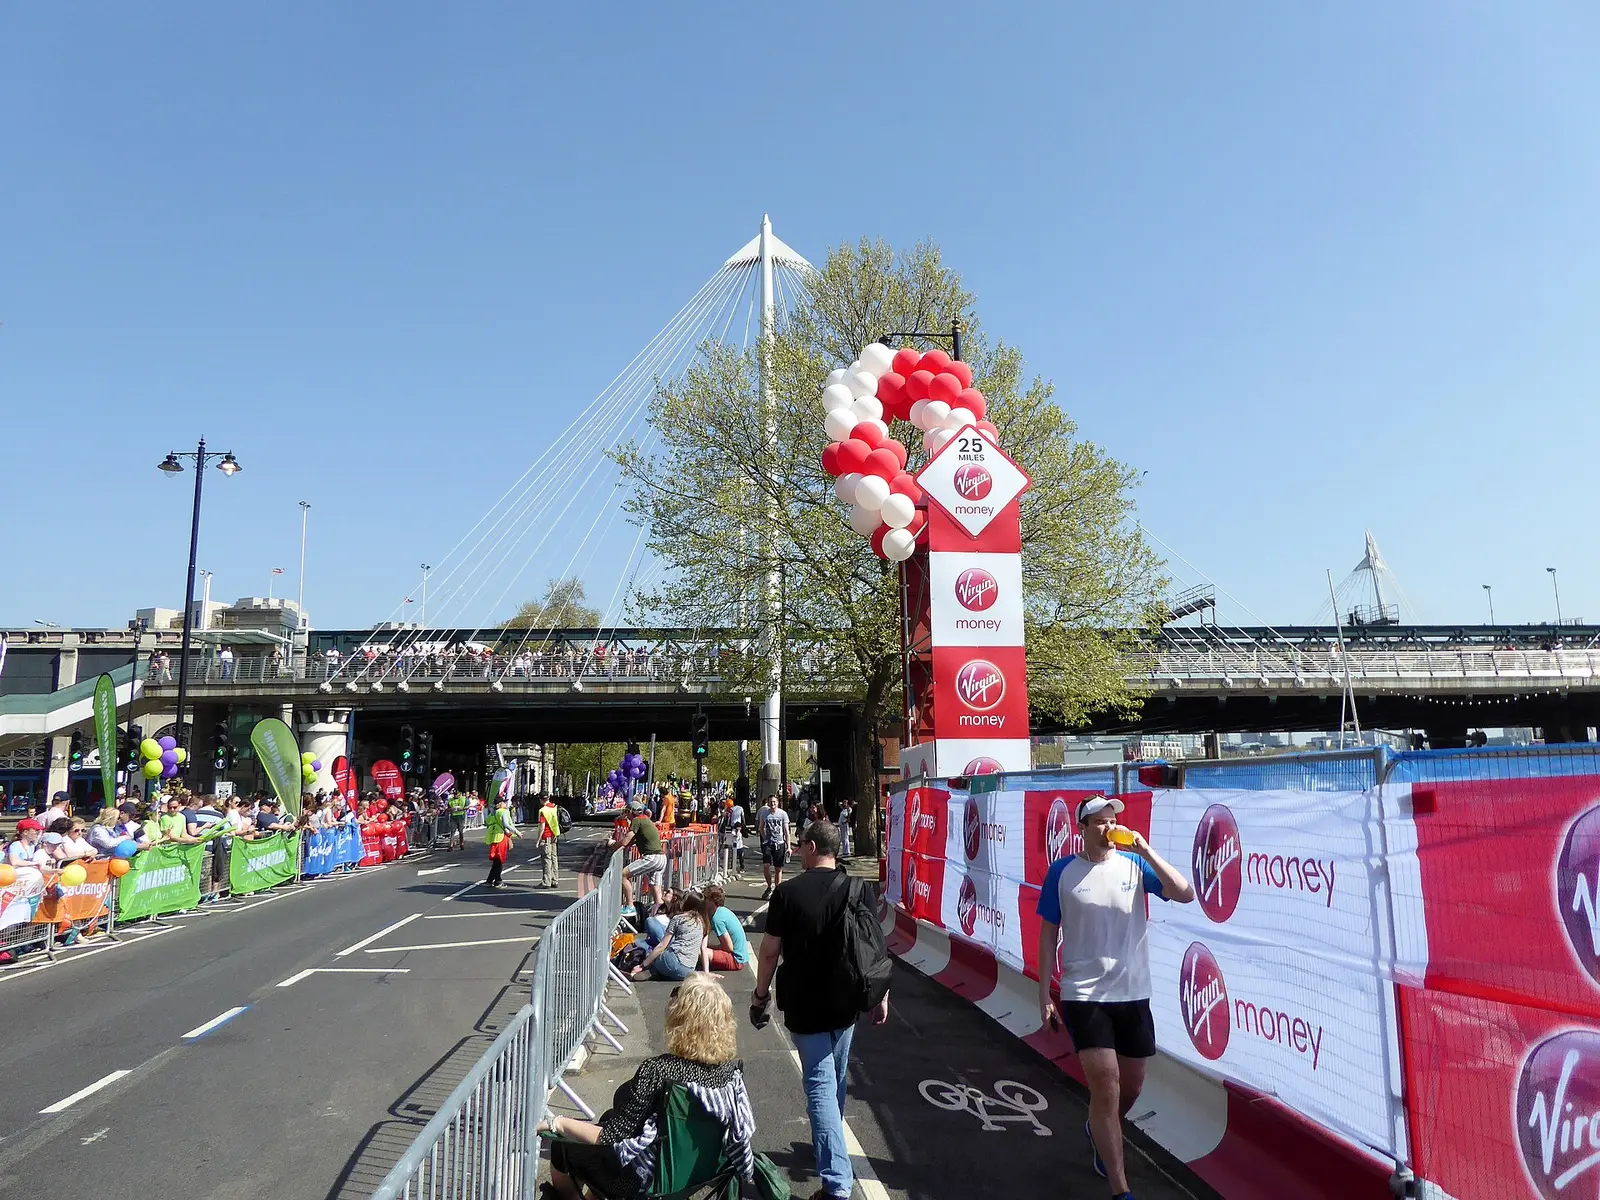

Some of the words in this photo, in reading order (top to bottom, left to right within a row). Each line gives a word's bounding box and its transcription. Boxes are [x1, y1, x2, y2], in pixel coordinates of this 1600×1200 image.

[958, 438, 983, 453] 25
[958, 454, 985, 462] MILES
[957, 467, 990, 497] Virgin
[955, 505, 994, 517] money
[958, 572, 996, 606] Virgin
[956, 619, 1001, 632] money
[961, 666, 1000, 703] Virgin
[959, 714, 1006, 729] money
[920, 813, 936, 835] money
[981, 822, 1007, 849] money
[1195, 816, 1239, 907] Virgin
[1247, 852, 1335, 908] money
[135, 864, 187, 893] SAMARITANS
[915, 878, 931, 904] money
[977, 903, 1006, 935] money
[1183, 951, 1225, 1045] Virgin
[1235, 998, 1323, 1071] money
